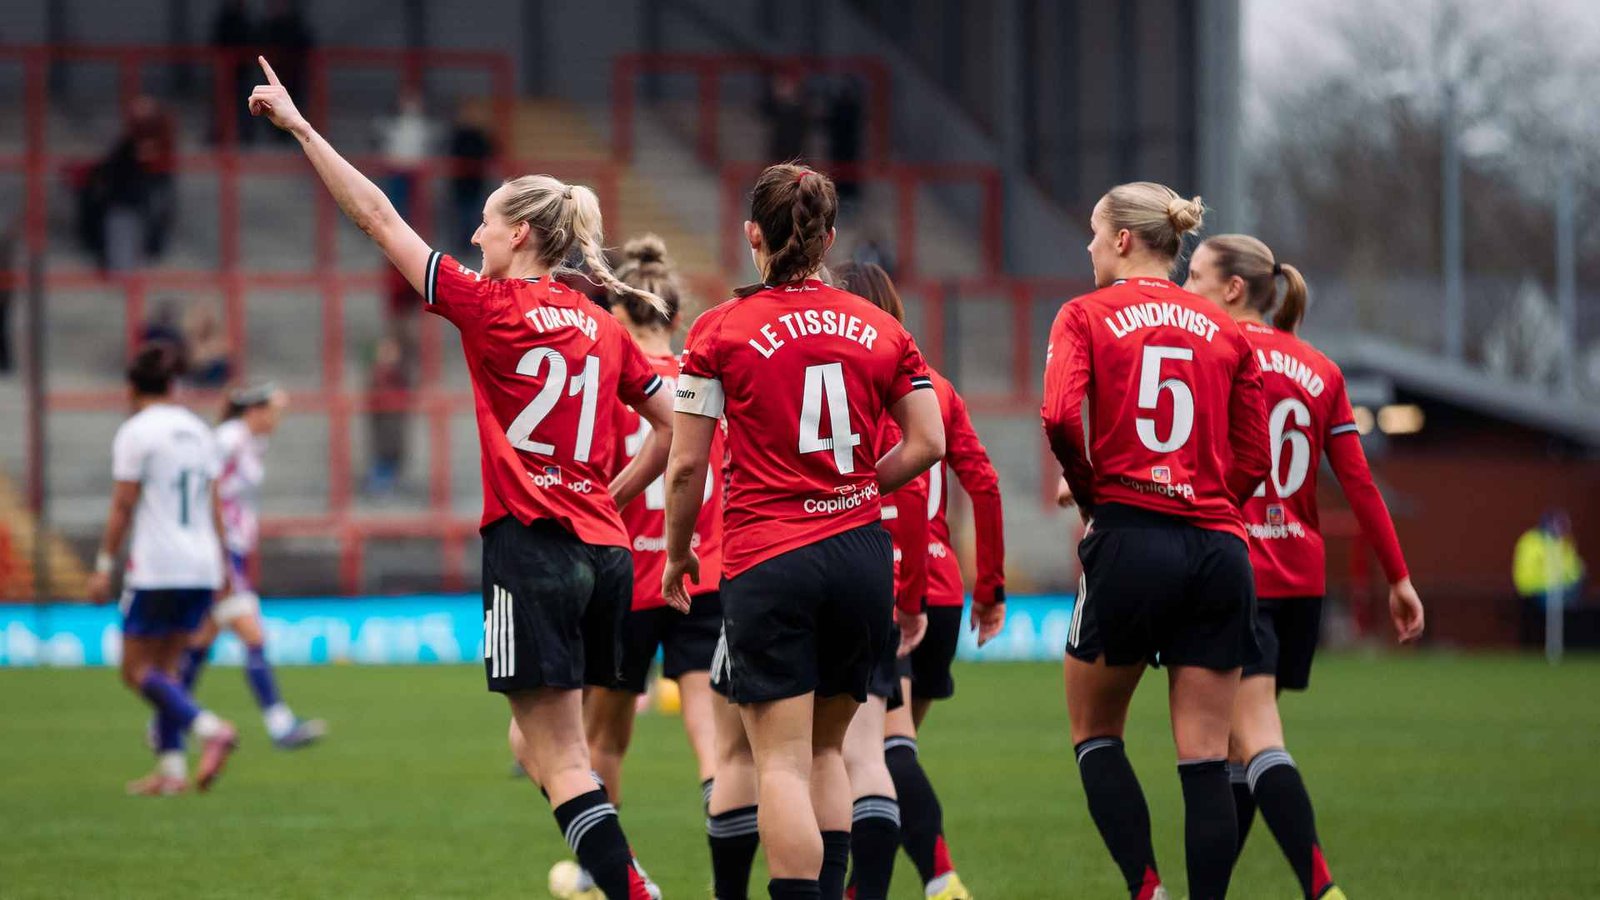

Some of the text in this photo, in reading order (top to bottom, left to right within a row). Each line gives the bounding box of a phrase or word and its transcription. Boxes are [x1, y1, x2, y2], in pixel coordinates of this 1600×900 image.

[525, 306, 599, 341] TURNER
[748, 309, 878, 359] LE TISSIER
[1104, 302, 1220, 343] LUNDKVIST
[506, 346, 600, 463] 21
[799, 361, 861, 475] 4
[1135, 345, 1194, 453] 5
[1253, 397, 1311, 498] 6
